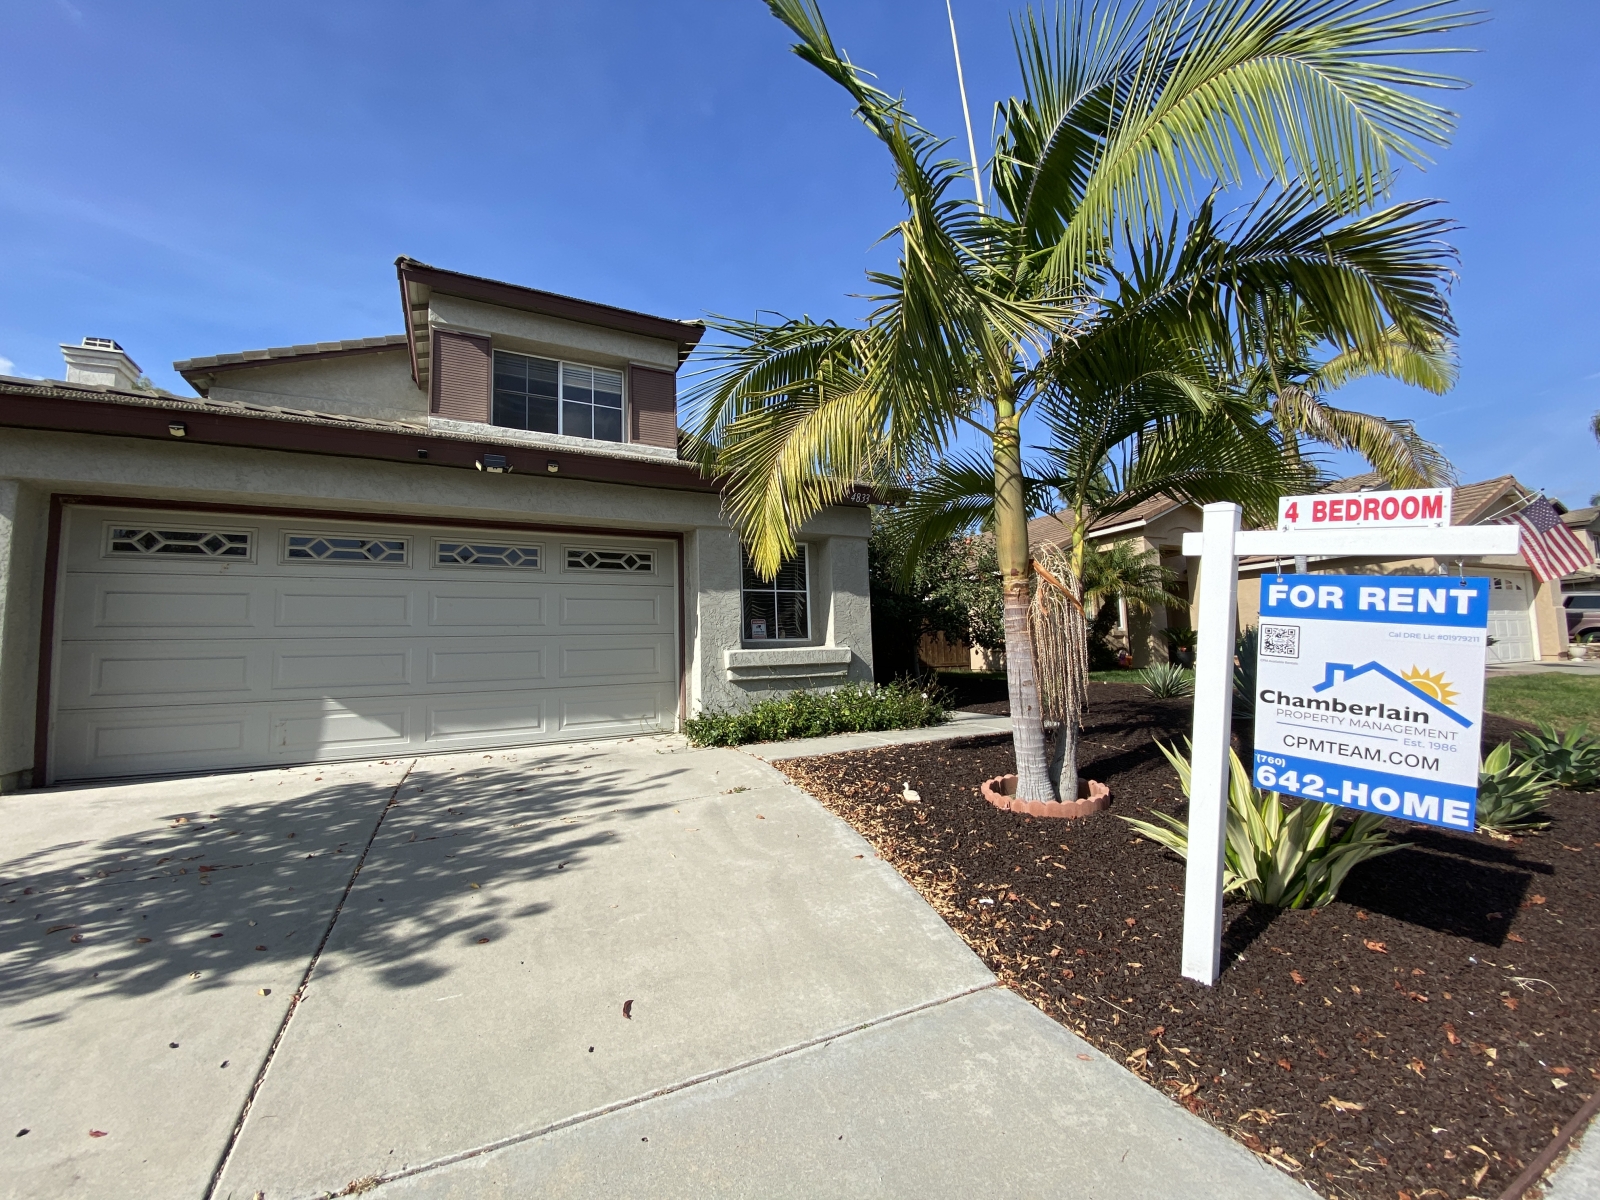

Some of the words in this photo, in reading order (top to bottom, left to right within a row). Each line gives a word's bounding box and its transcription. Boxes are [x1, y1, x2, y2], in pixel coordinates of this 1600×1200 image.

[1284, 502, 1299, 523] 4
[1312, 495, 1443, 523] BEDROOM
[1268, 585, 1344, 609] FOR
[1359, 587, 1478, 615] RENT
[1437, 634, 1480, 643] #01979211
[1259, 689, 1429, 725] Chamberlain
[1276, 708, 1346, 726] PROPERTY
[1349, 718, 1459, 741] MANAGEMENT
[1256, 753, 1287, 768] (760)
[1283, 734, 1440, 772] CPMTEAM.COM
[1403, 738, 1426, 749] Est.
[1428, 741, 1458, 753] 1986
[1256, 765, 1470, 827] 642-HOME
